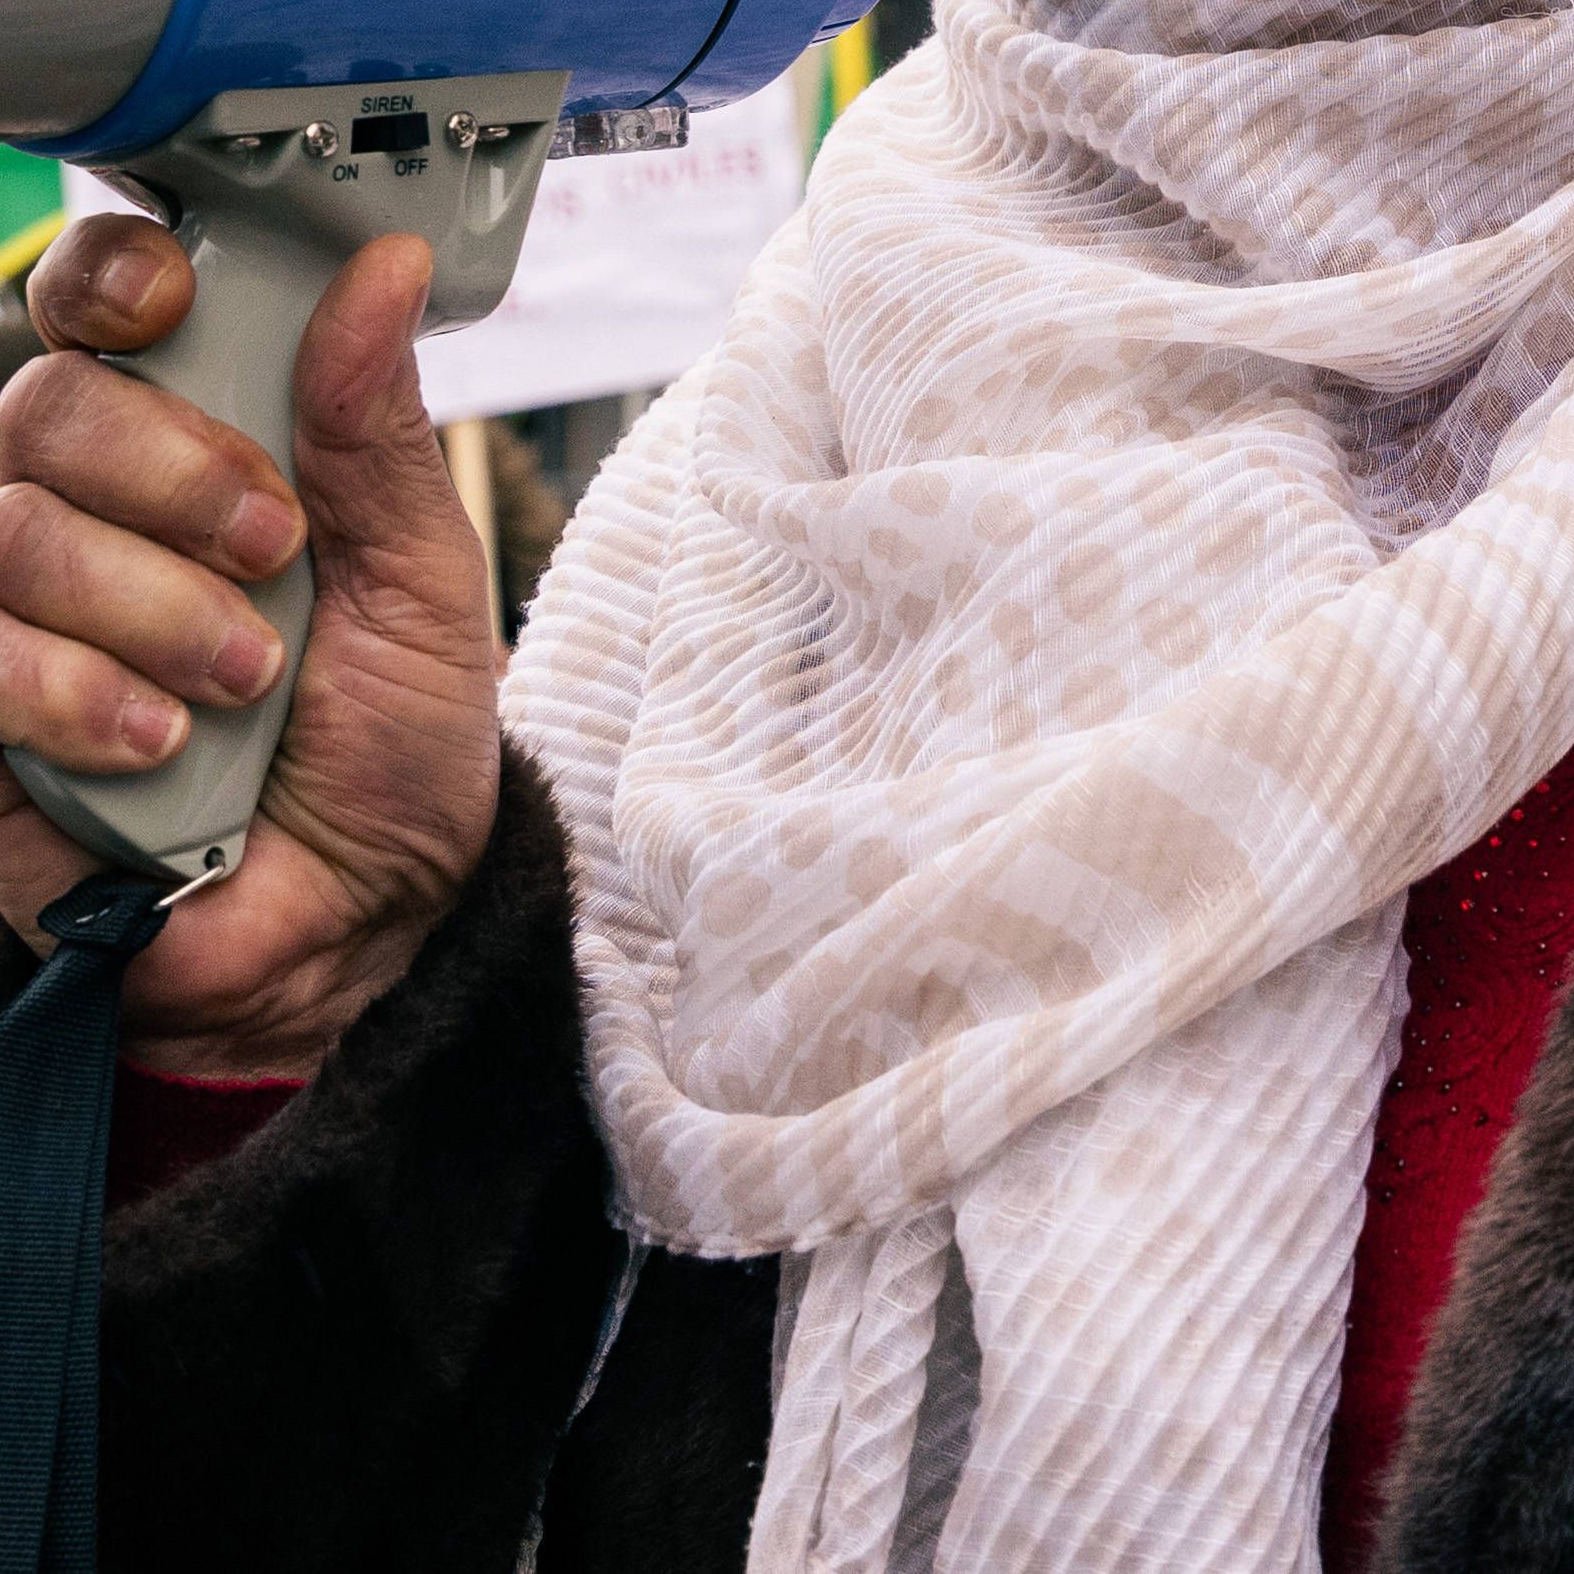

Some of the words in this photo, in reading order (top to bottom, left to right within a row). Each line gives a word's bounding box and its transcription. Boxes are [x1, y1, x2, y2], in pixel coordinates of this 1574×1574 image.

[360, 95, 414, 113] SIREN
[332, 163, 359, 182] ON
[394, 158, 428, 177] OFF
